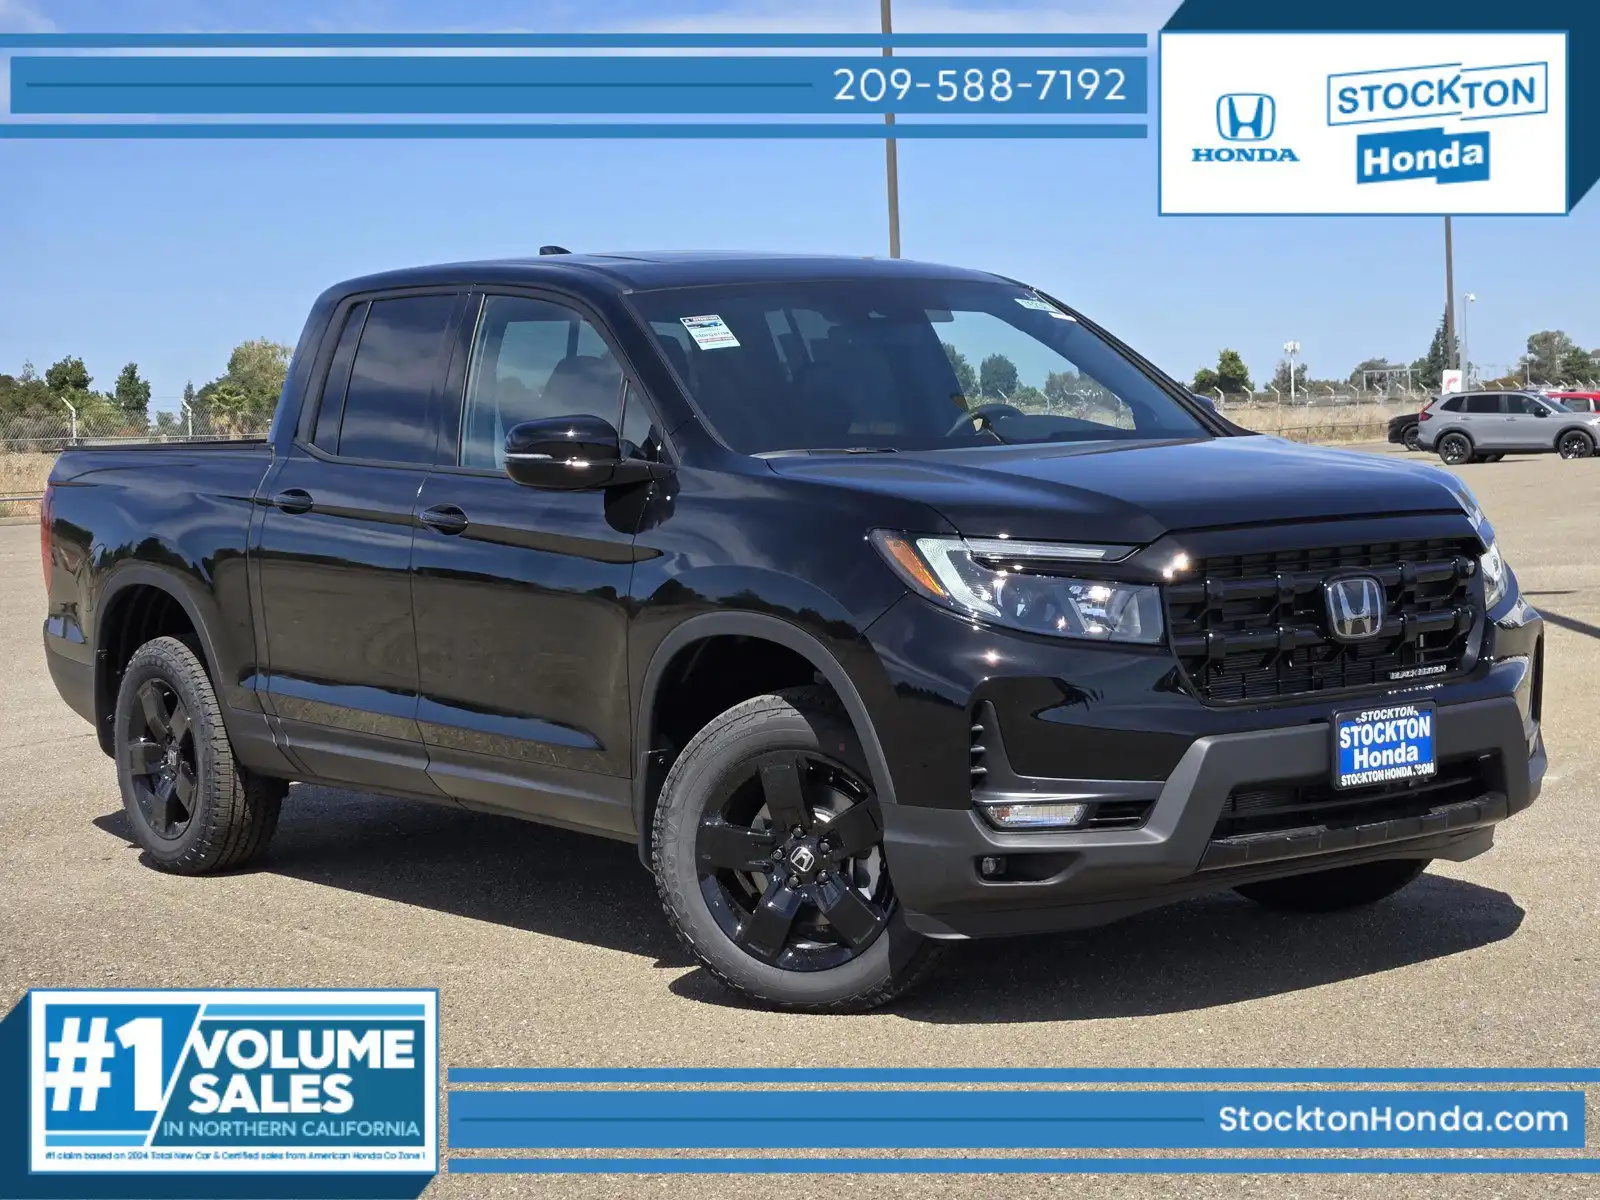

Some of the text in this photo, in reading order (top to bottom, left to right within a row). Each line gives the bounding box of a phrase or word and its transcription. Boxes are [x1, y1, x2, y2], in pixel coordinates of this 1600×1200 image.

[1360, 705, 1415, 723] STOCKTON
[1339, 716, 1431, 749] STOCKTON
[1353, 742, 1419, 770] Honda
